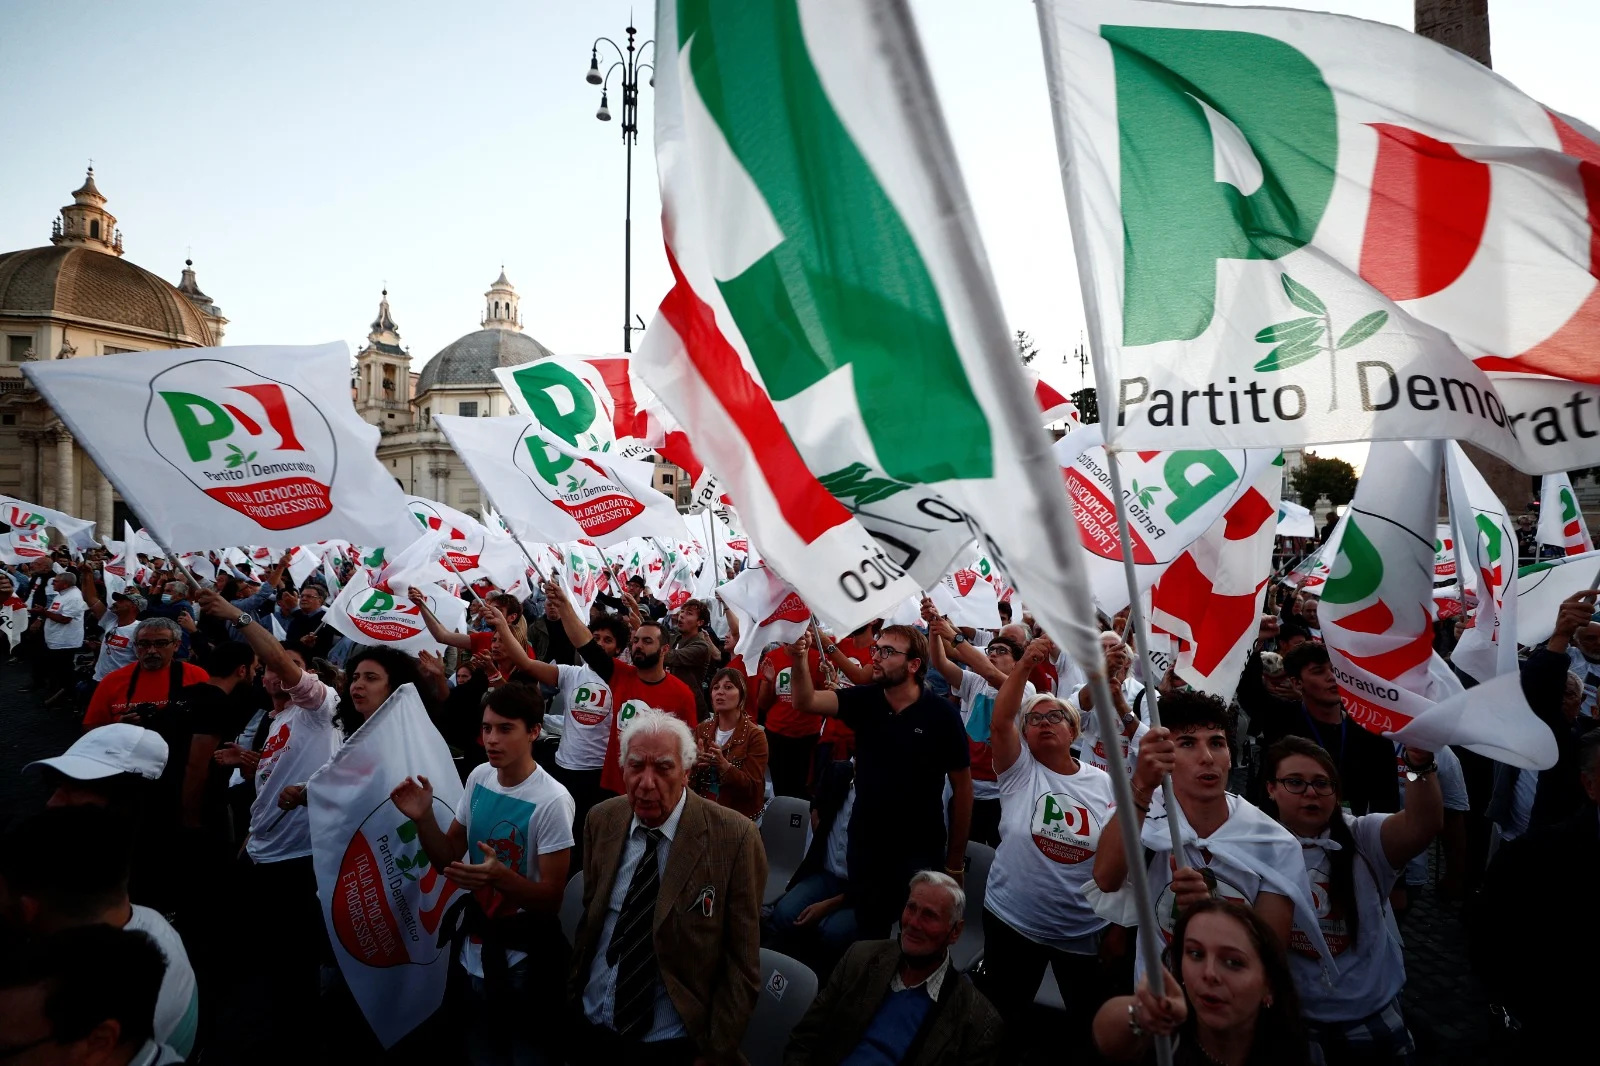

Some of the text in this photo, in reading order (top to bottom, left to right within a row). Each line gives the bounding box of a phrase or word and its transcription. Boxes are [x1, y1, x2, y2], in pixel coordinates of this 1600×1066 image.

[1117, 376, 1307, 427] Partito
[203, 462, 316, 482] Partito Democratico
[226, 491, 254, 505] ITALIA
[249, 498, 327, 518] PROGRESSISTA
[585, 498, 635, 517] DEMOCRATICA
[1333, 666, 1399, 702] ocratico
[376, 835, 394, 875] Partito
[343, 872, 378, 959] E PROGRESSISTA
[354, 853, 397, 957] ITALIA DEMOCRATICA
